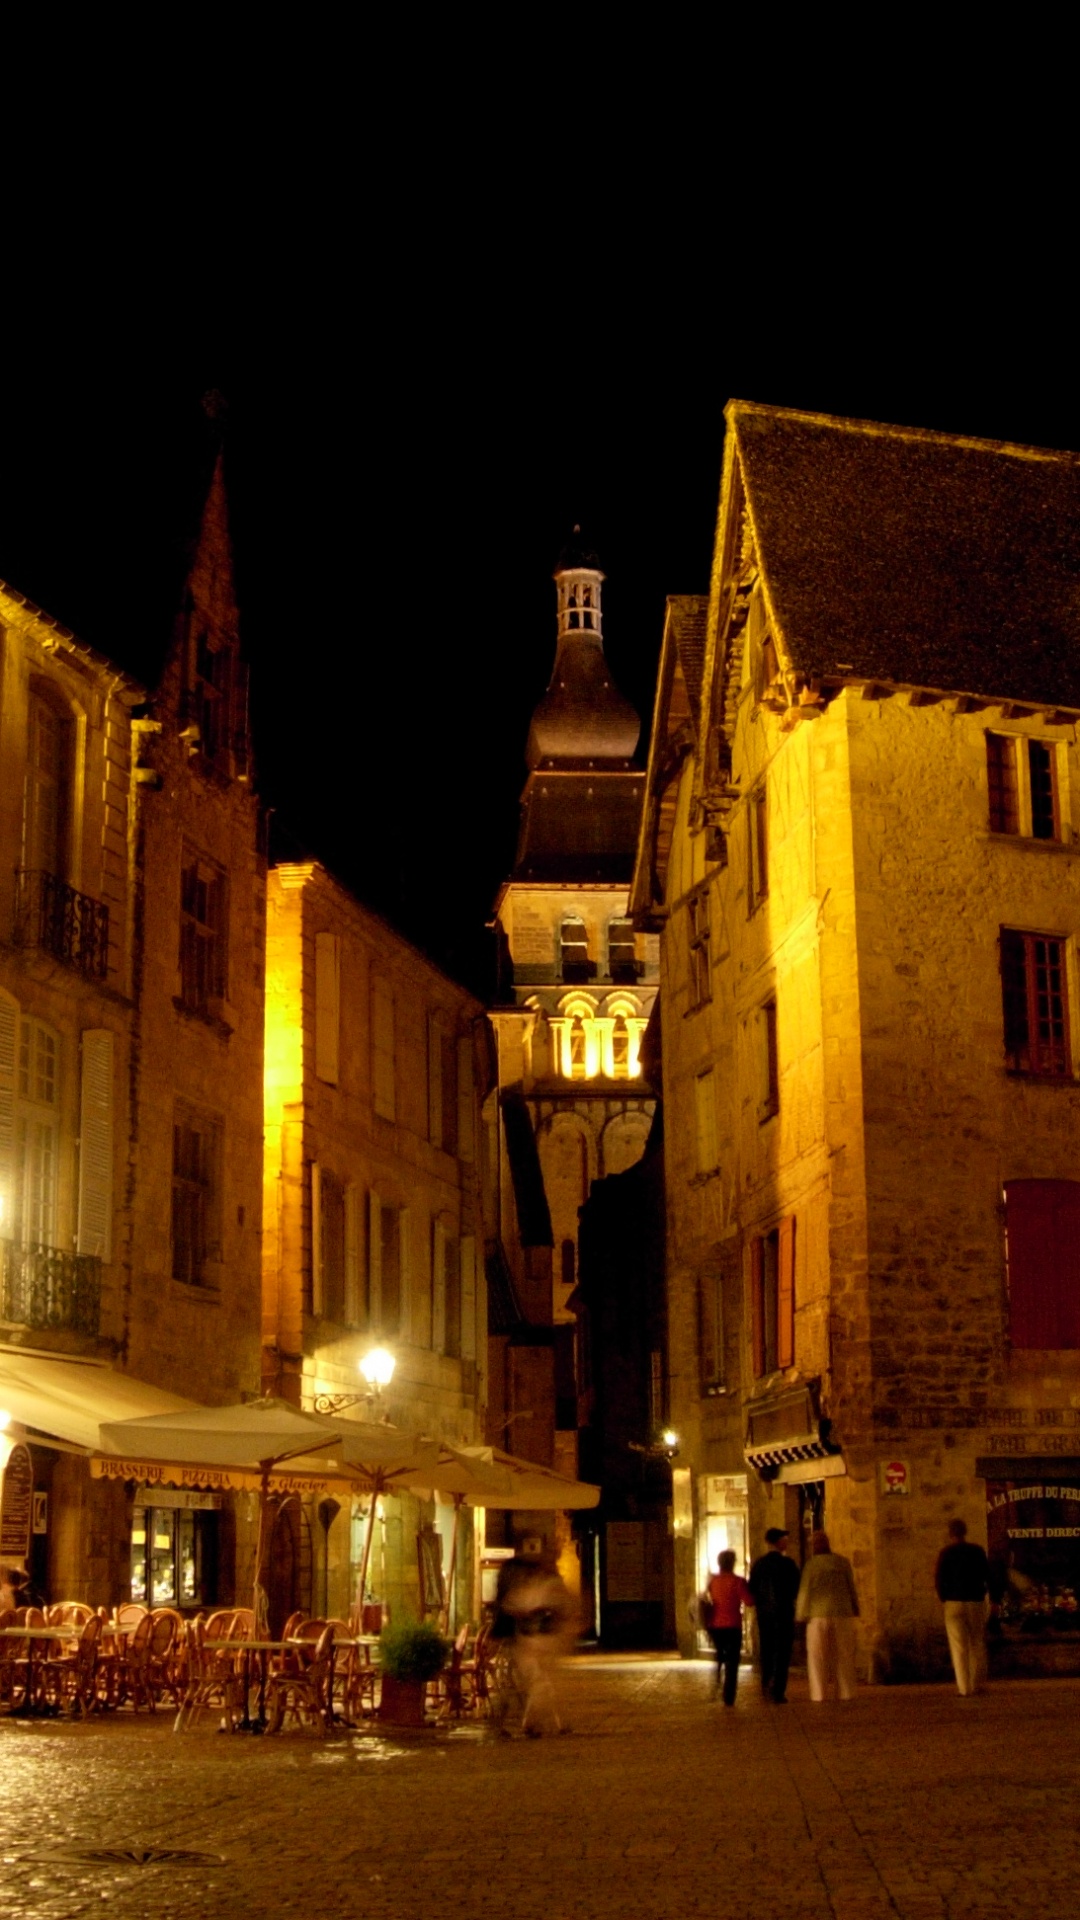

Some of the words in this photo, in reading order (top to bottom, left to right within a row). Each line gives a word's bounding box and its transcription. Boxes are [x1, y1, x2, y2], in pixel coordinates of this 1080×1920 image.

[101, 1461, 163, 1480] BRASSERIE
[182, 1470, 230, 1485] PIZZERIA
[279, 1478, 327, 1490] Glacier
[994, 1492, 1007, 1508] LA
[1007, 1486, 1043, 1503] TRUFFE
[1045, 1486, 1058, 1499] DU
[1007, 1528, 1043, 1538] VENTE
